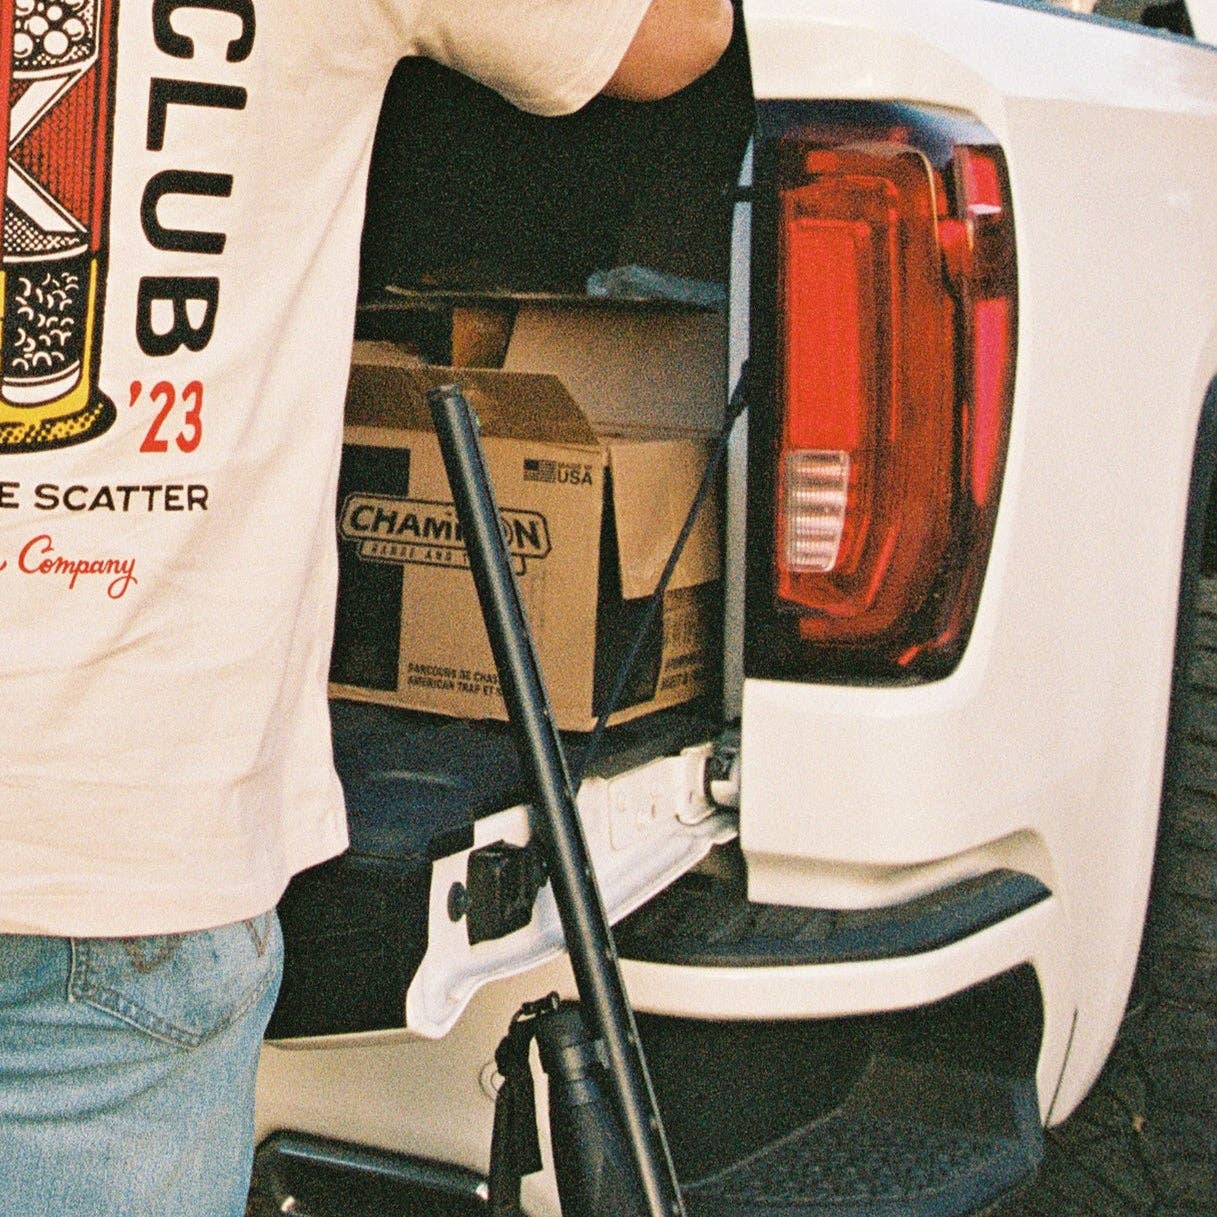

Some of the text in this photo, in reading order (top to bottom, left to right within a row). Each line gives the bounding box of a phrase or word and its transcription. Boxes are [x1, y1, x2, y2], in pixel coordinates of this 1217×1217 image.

[129, 379, 204, 454] '23
[35, 483, 209, 512] SCATTER
[557, 469, 593, 486] USA
[17, 533, 139, 601] Company
